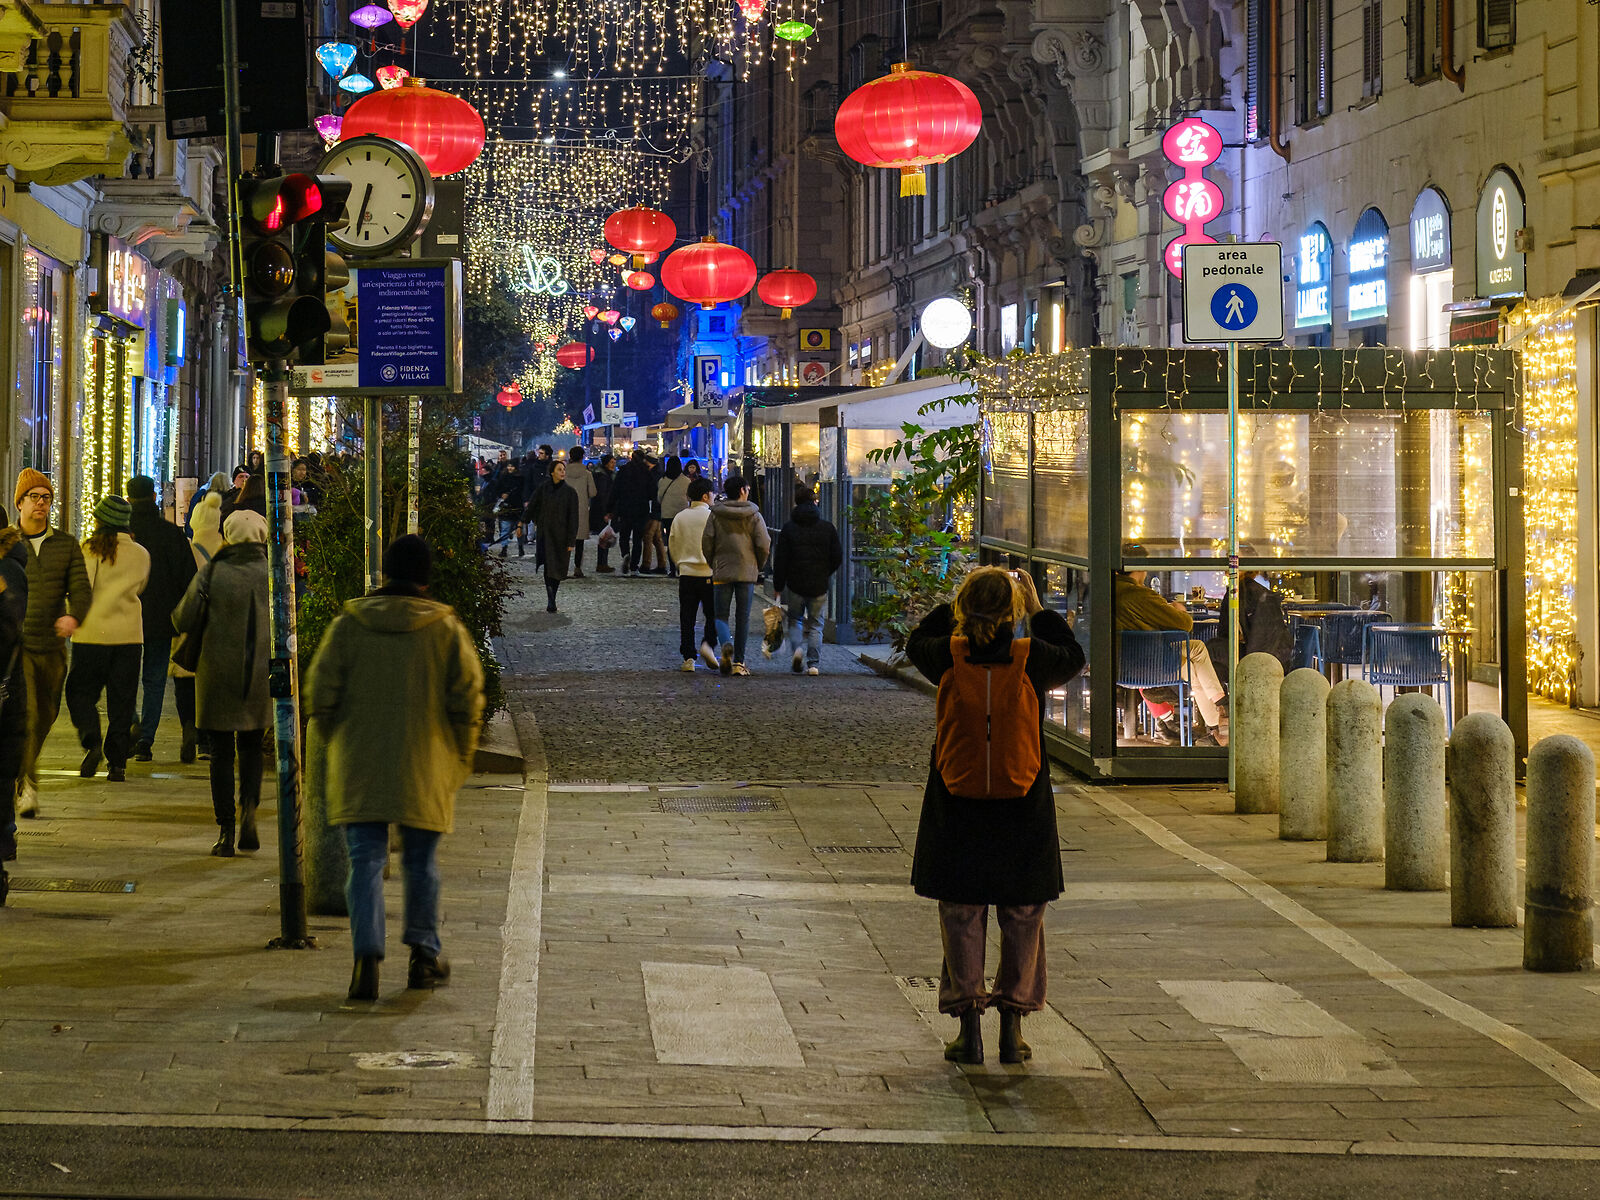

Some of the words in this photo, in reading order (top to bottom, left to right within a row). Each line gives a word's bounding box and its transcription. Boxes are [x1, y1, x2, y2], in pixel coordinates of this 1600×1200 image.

[1219, 252, 1247, 260] area
[1203, 264, 1263, 277] pedonale
[705, 362, 715, 380] P
